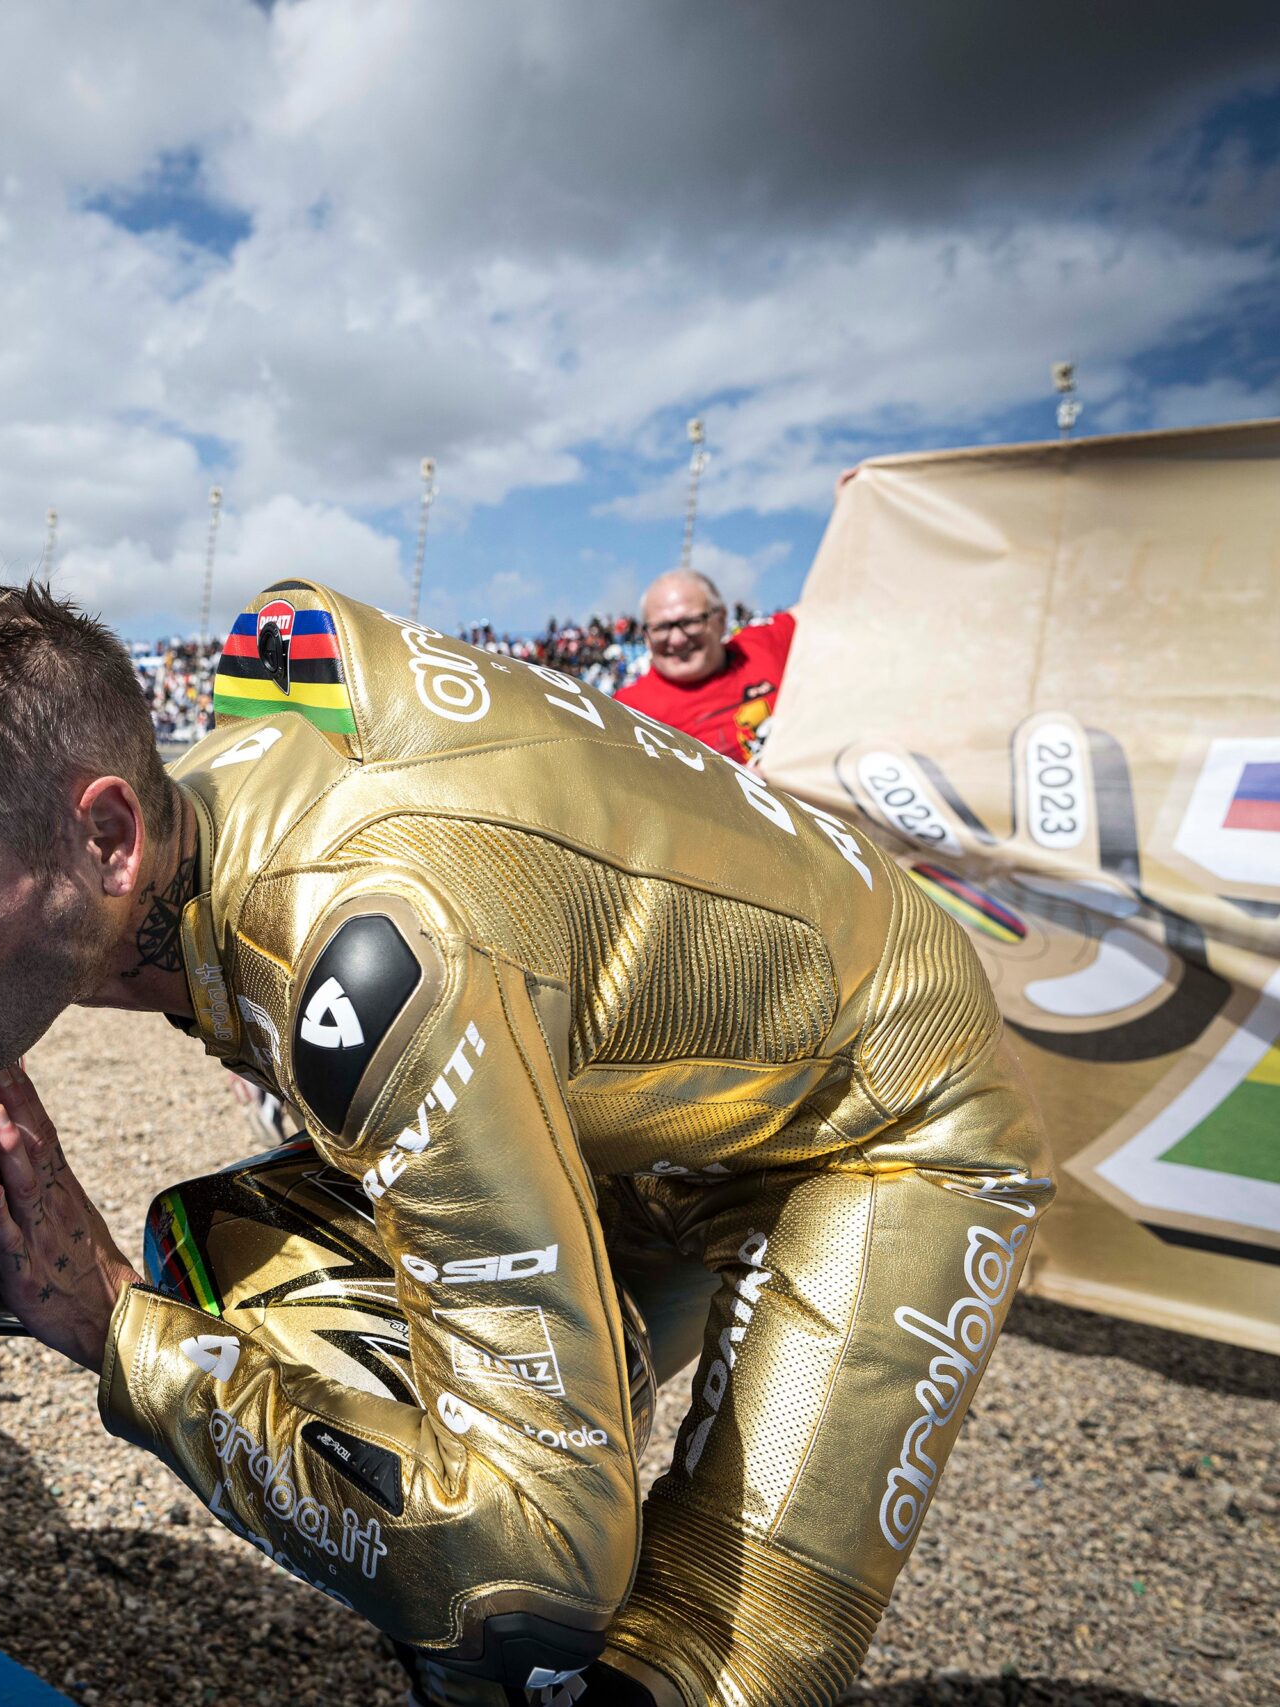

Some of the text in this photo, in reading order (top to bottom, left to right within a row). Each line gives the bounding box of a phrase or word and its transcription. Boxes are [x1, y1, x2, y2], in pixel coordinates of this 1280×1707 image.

[869, 766, 947, 843] 2022
[1037, 742, 1077, 835] 2023
[195, 963, 233, 1040] aruba.it
[362, 1020, 486, 1199] REV'IT!
